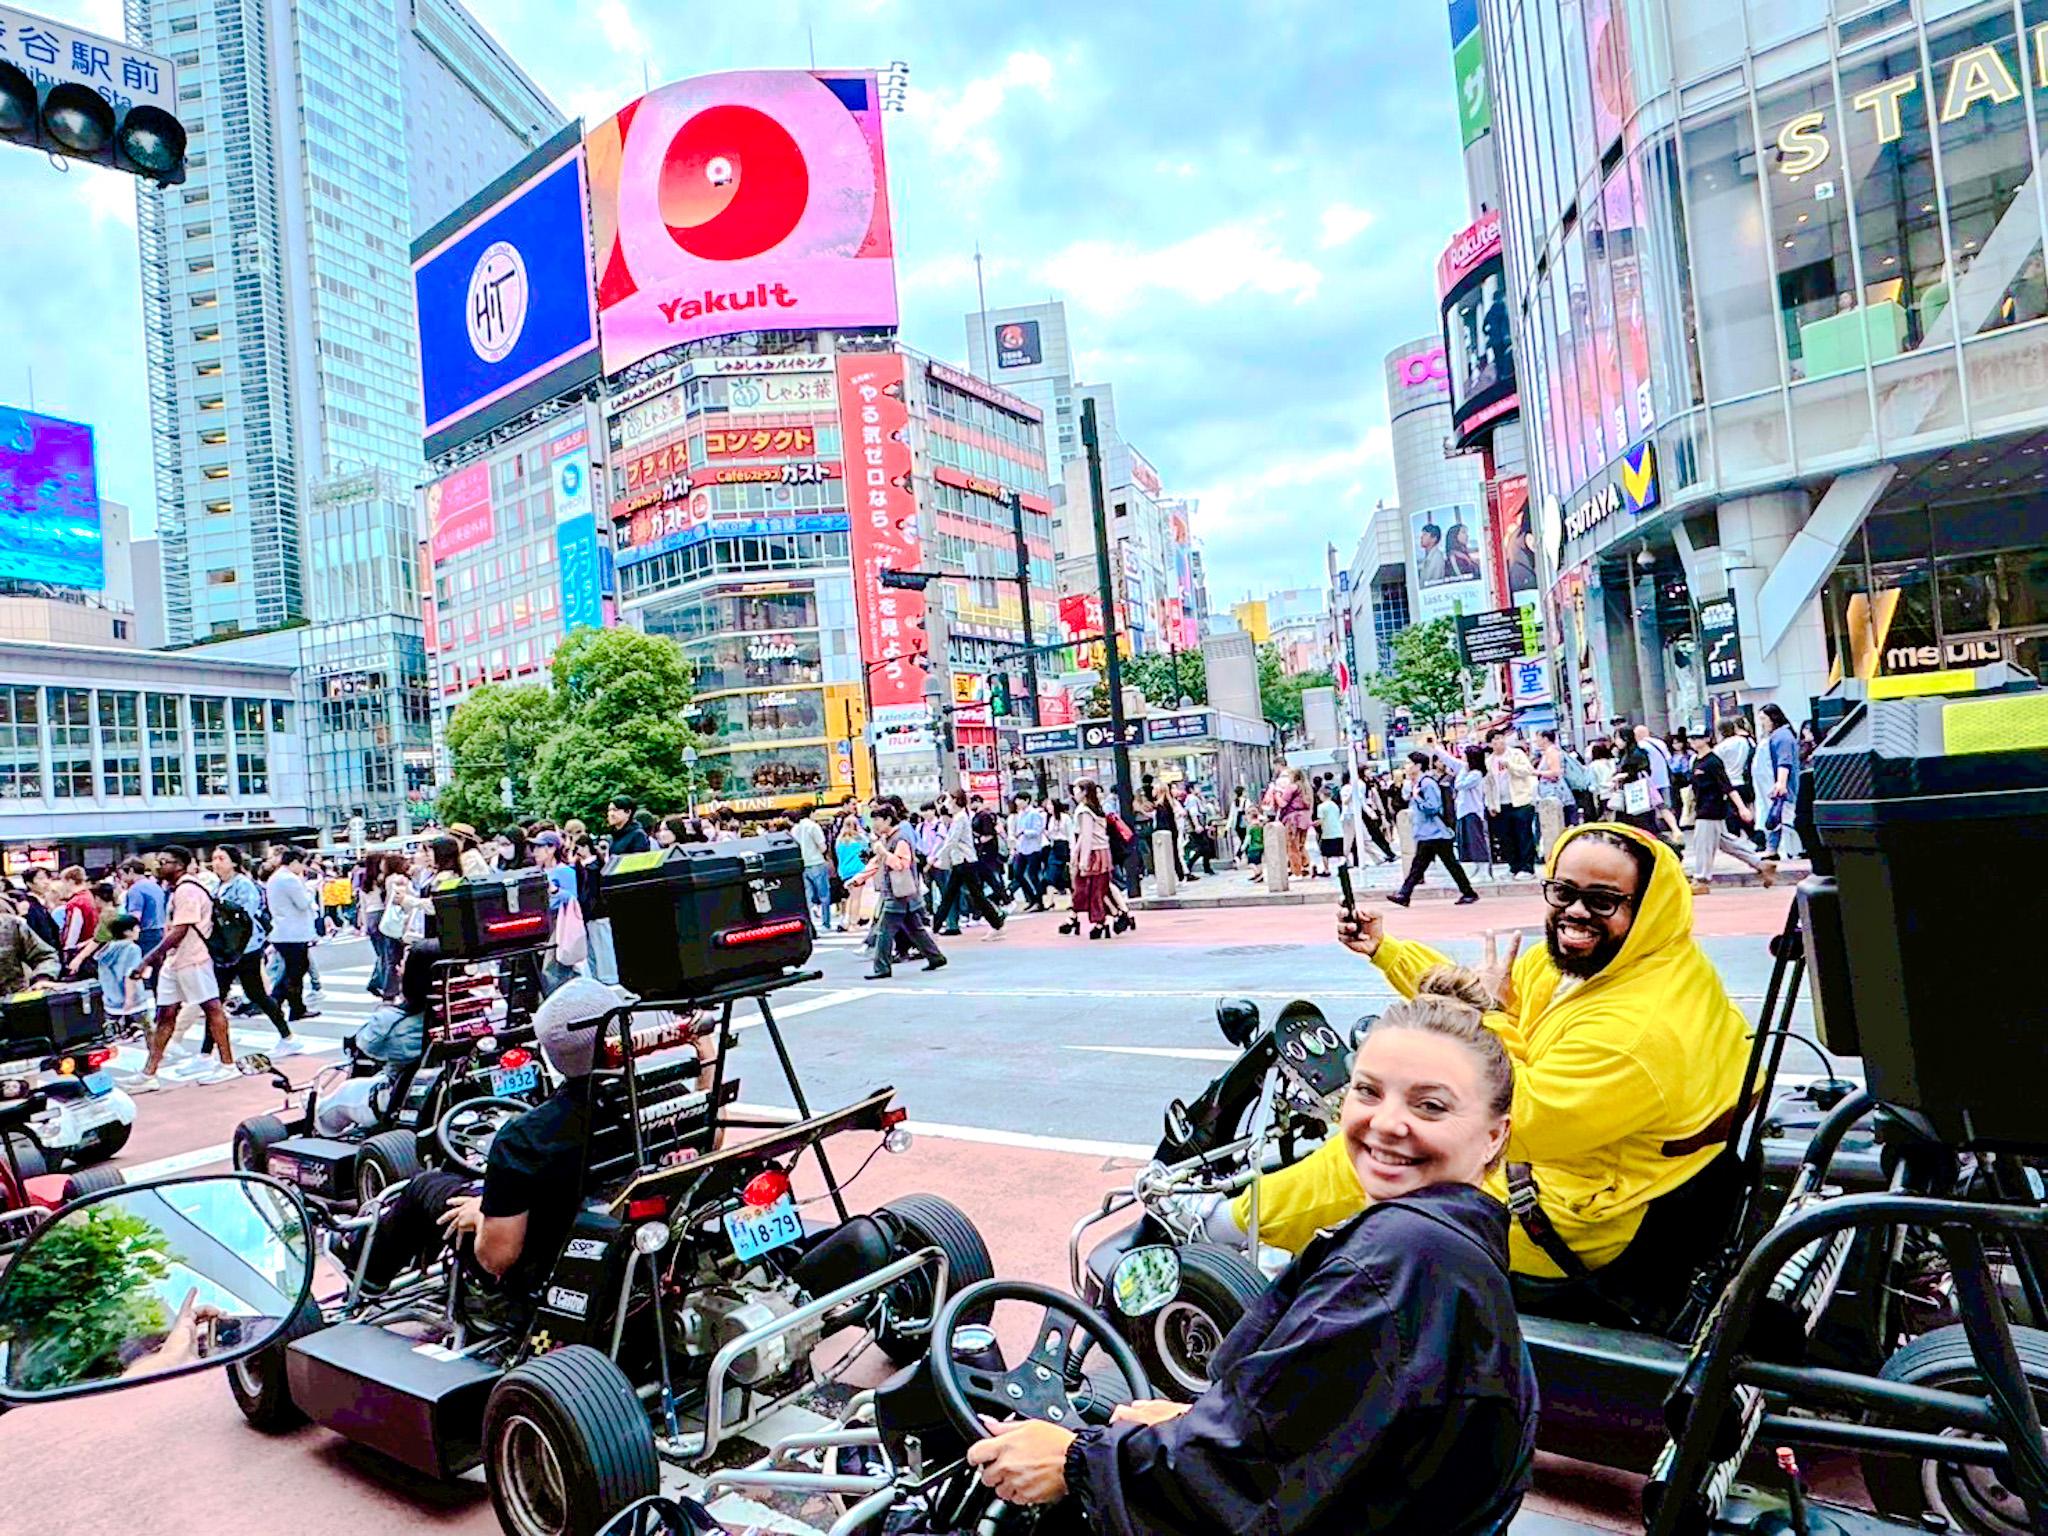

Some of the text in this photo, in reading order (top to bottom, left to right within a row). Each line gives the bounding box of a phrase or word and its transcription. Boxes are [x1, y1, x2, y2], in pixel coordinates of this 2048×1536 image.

[657, 282, 798, 324] Yakult
[706, 429, 813, 453] コンタクト
[781, 463, 831, 484] ガスト
[662, 475, 694, 501] ガスト
[650, 506, 689, 537] ガスト
[1565, 483, 1620, 542] TSUTAYA
[616, 525, 632, 544] 7F
[1710, 659, 1737, 678] B1F
[749, 1214, 795, 1247] 18-79
